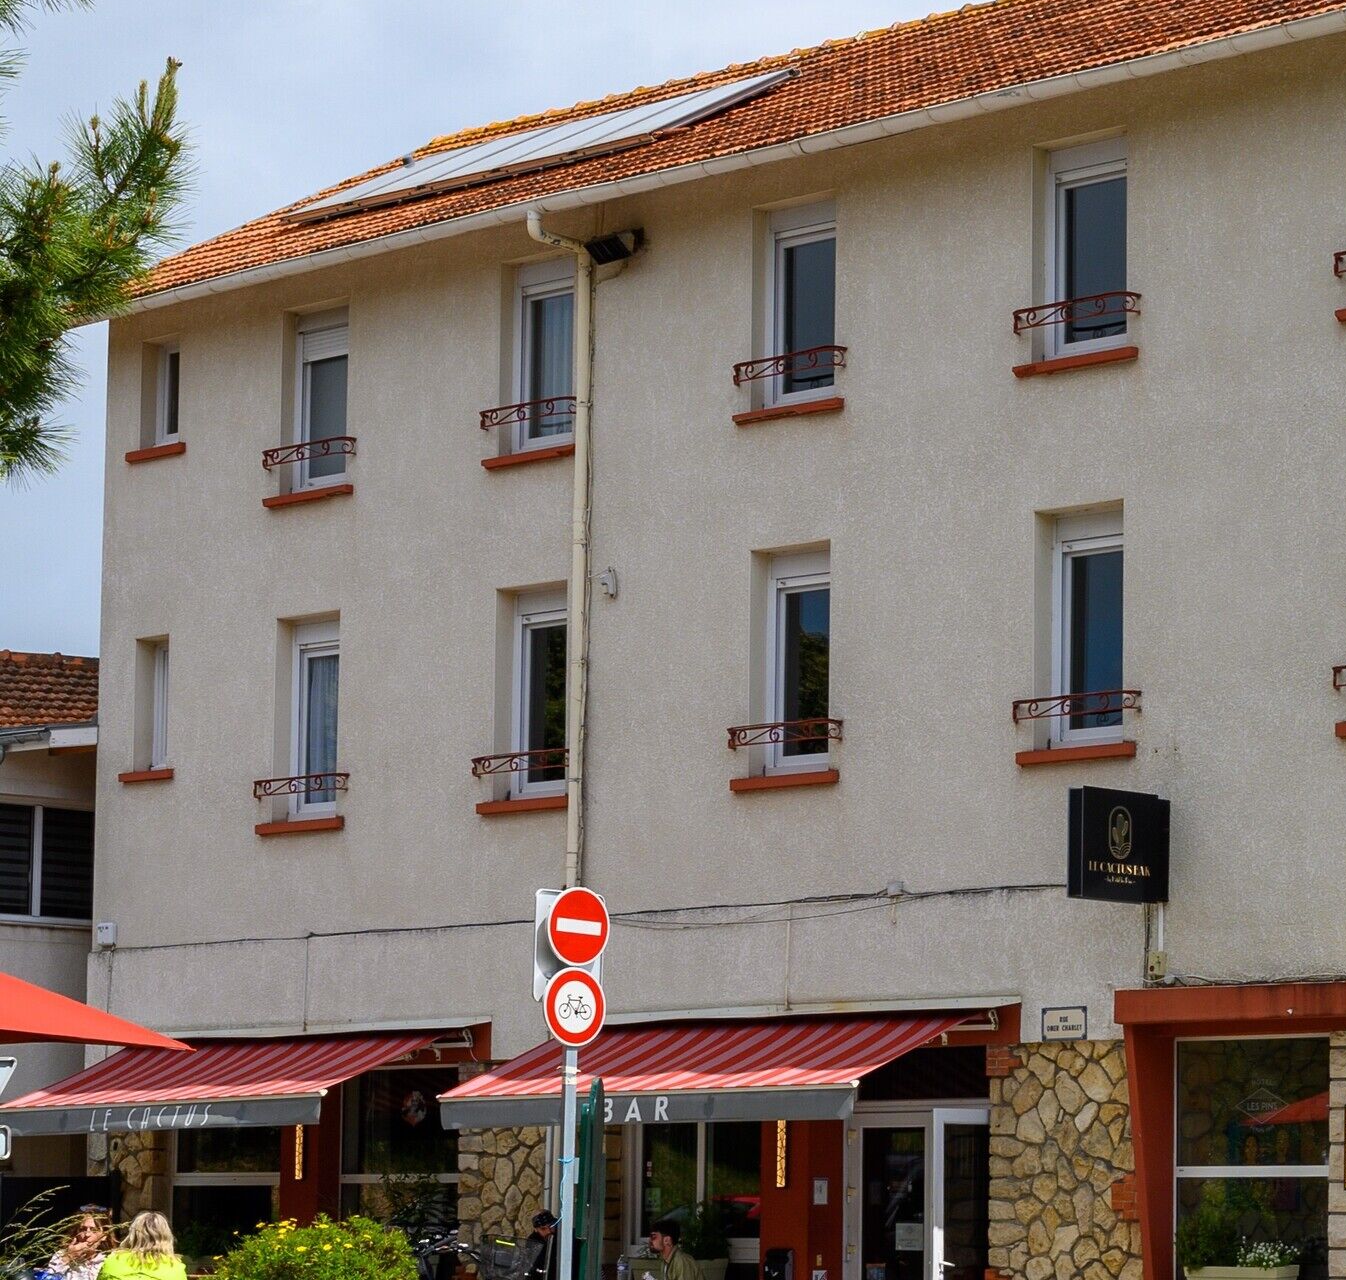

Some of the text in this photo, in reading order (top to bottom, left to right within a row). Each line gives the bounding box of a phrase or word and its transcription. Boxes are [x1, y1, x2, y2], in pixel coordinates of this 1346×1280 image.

[90, 1104, 212, 1131] LE CACTUS
[604, 1096, 669, 1123] BAR
[1246, 1102, 1259, 1111] LES
